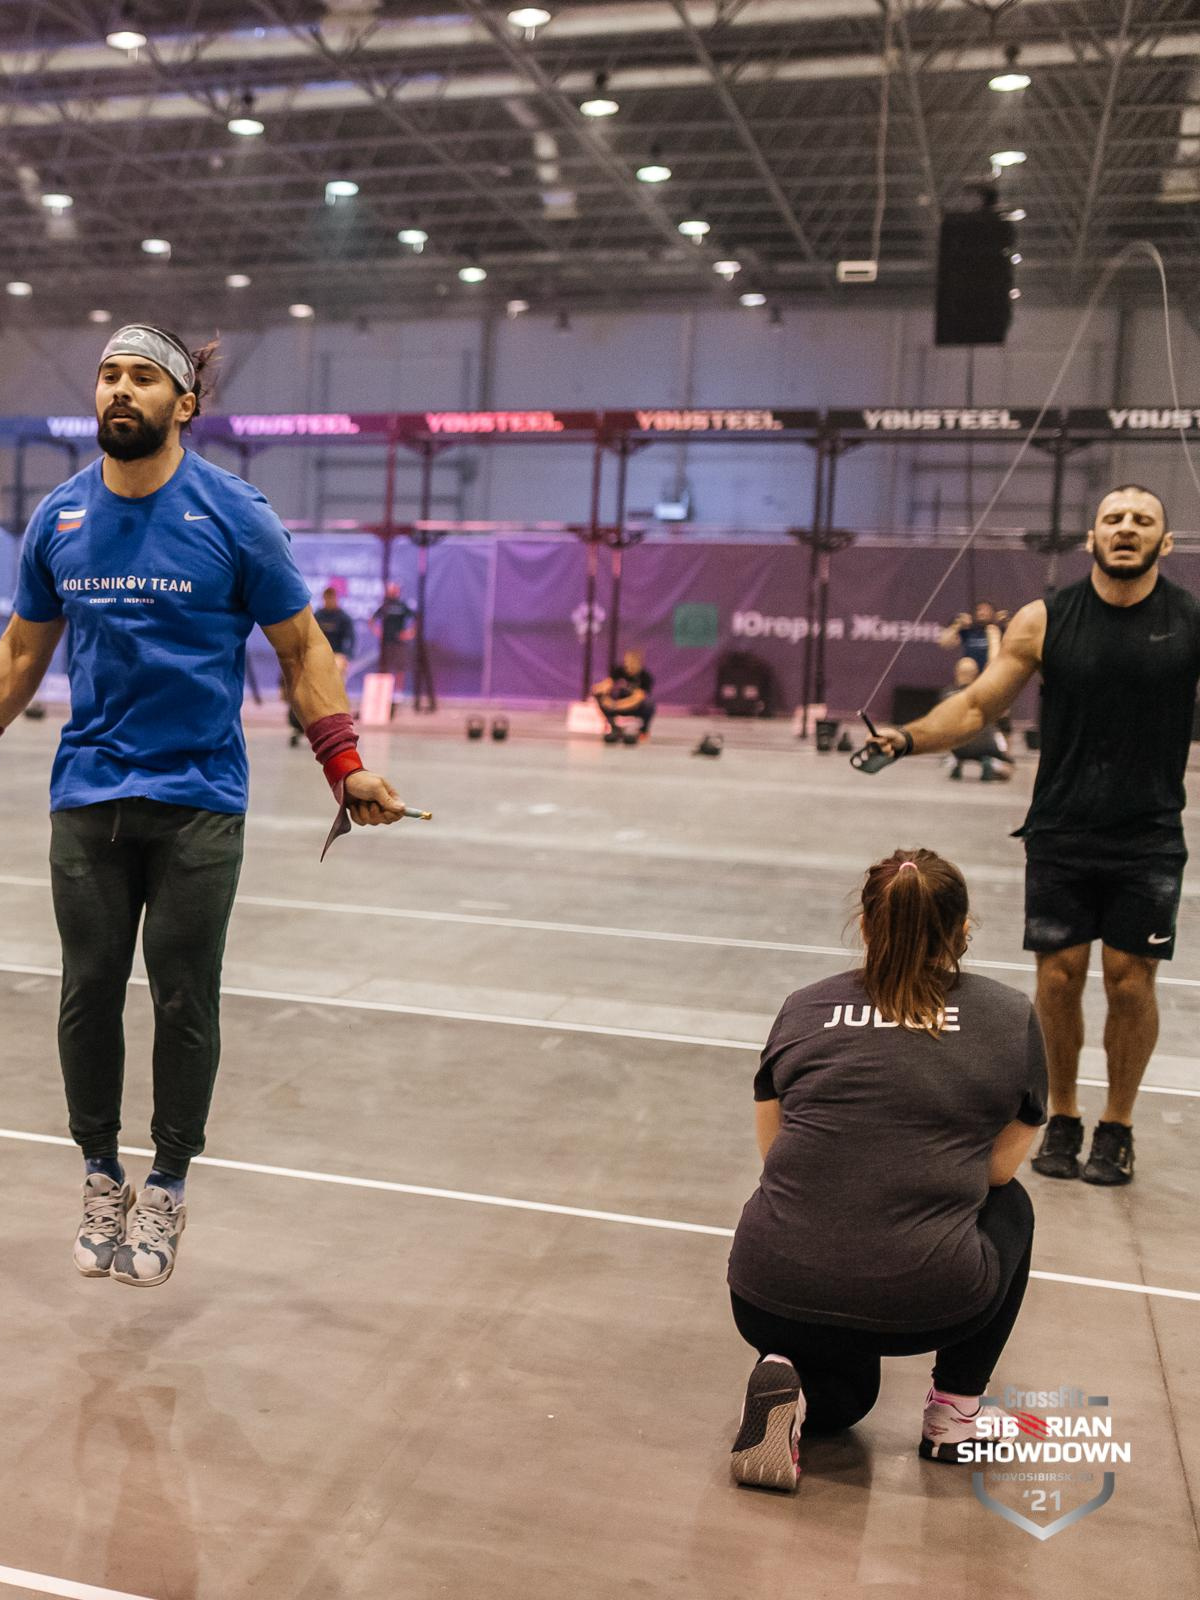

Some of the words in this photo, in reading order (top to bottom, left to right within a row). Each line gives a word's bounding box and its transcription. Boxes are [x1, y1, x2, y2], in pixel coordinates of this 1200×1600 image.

[635, 410, 783, 431] YOUSTEEL
[862, 409, 1021, 430] YOUSTEEL
[63, 575, 146, 591] KOLESNIKOV
[152, 578, 192, 593] TEAM
